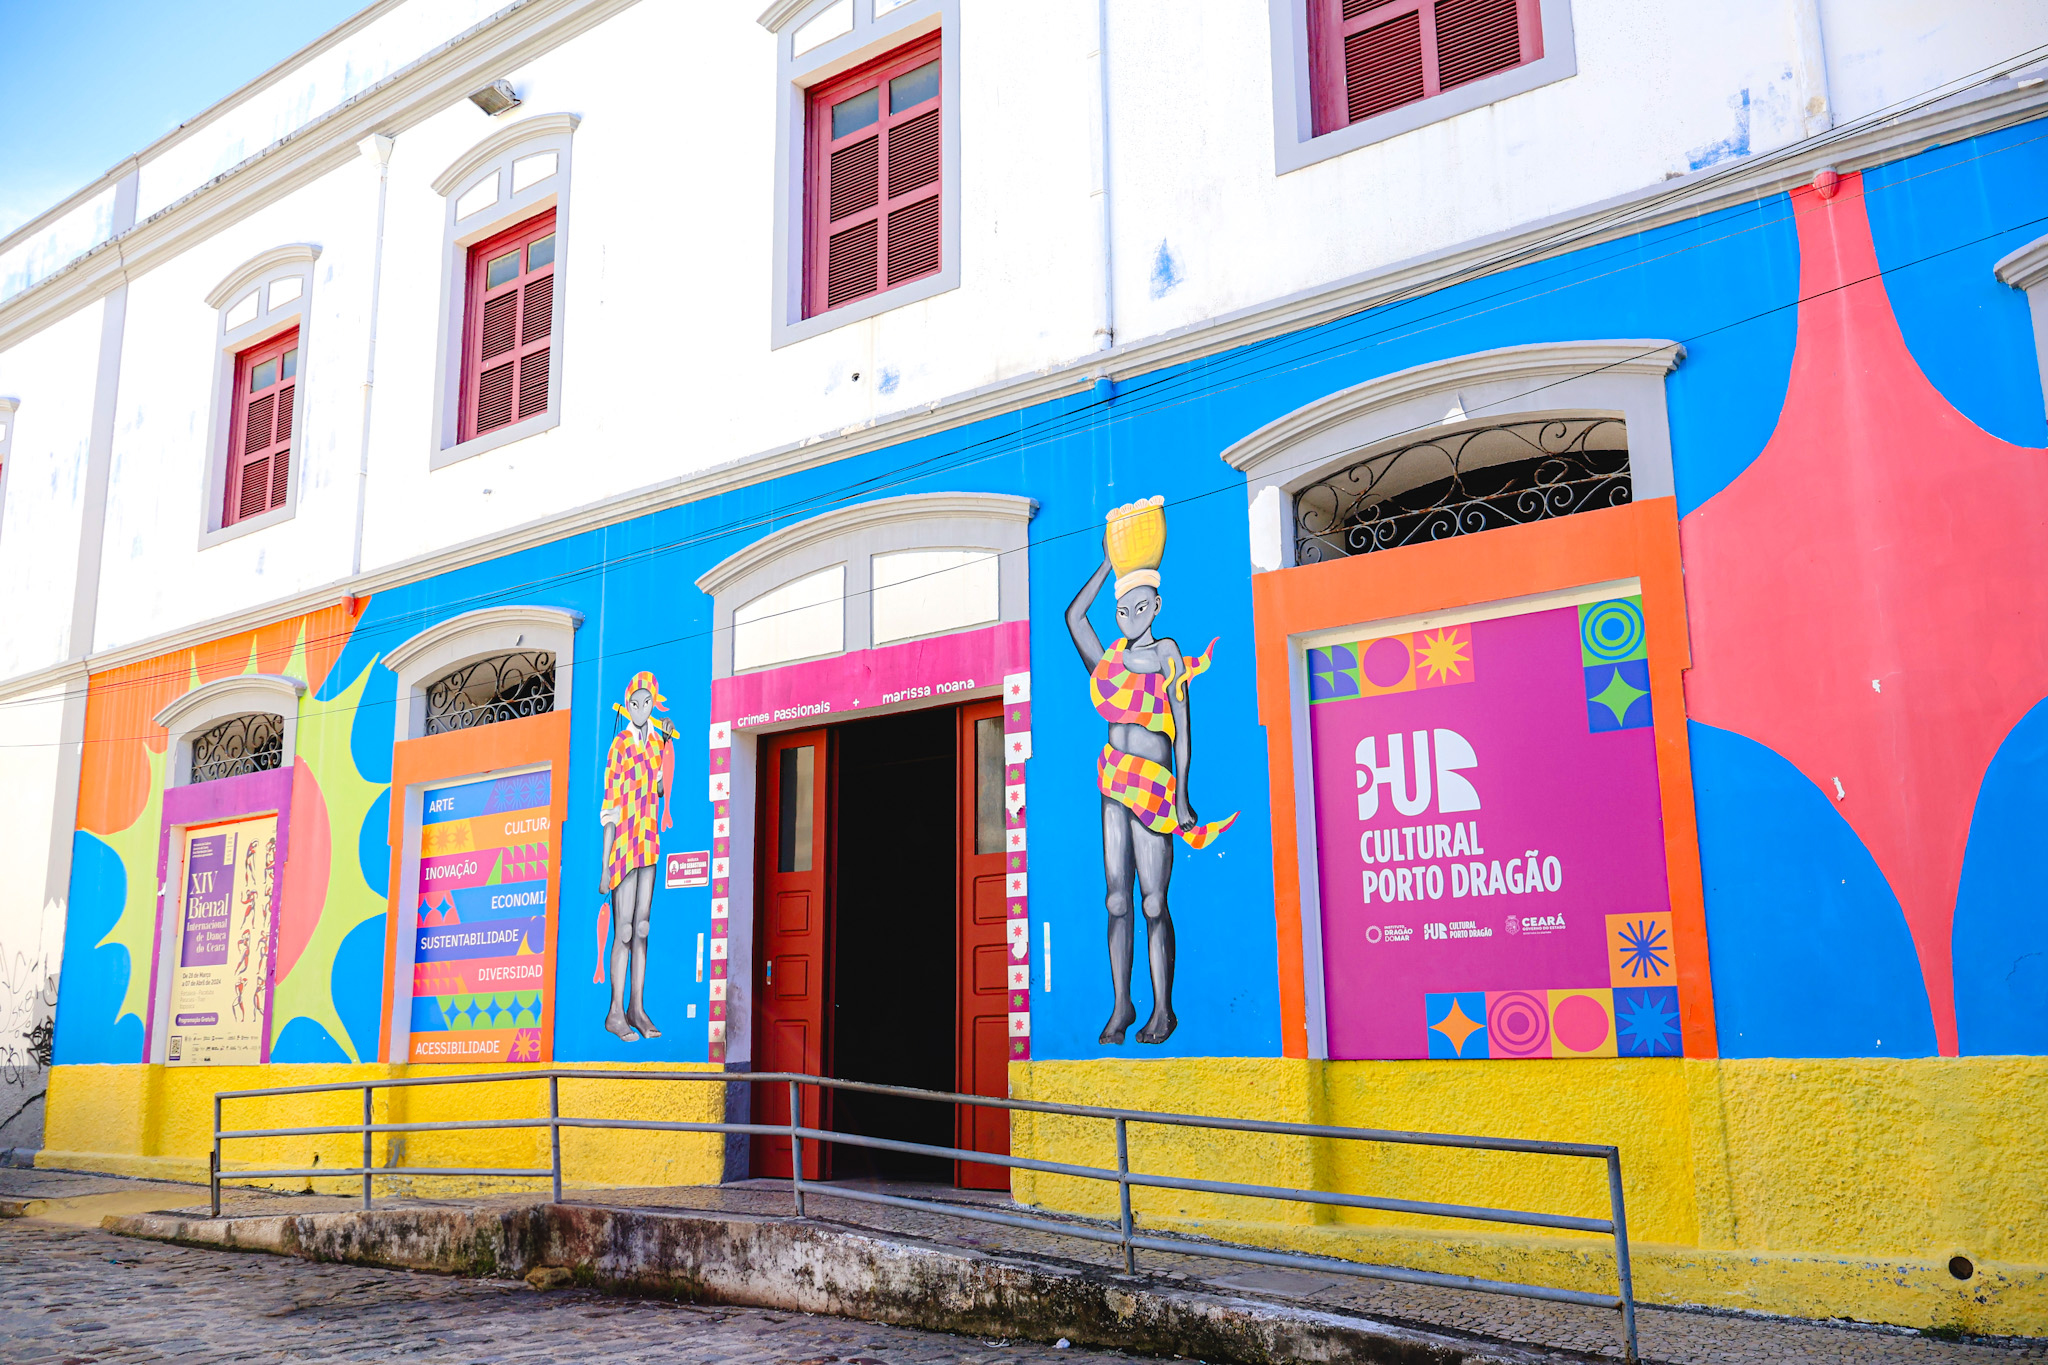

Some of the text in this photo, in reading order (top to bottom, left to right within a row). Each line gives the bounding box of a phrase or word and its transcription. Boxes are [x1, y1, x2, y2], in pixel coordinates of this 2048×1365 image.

[737, 710, 770, 728] crimes
[774, 701, 831, 721] passionais
[882, 684, 931, 704] marissa
[936, 678, 975, 694] noana
[1355, 728, 1481, 820] HUB
[429, 797, 455, 813] ARTE
[1360, 821, 1484, 864] CULTURAL
[425, 859, 478, 880] INOVAÇÃO
[1362, 850, 1562, 904] PORTO DRAGÃO
[190, 871, 218, 894] XIV
[188, 893, 229, 919] Bienal
[491, 890, 547, 909] ECONOMI
[186, 919, 227, 931] Internacional
[1449, 921, 1476, 930] CULTURAL
[1521, 912, 1566, 927] CEARÁ
[196, 931, 226, 942] de Dança
[420, 929, 519, 950] SUSTENTABILIDADE
[1384, 927, 1413, 935] DRAGÃO
[1450, 927, 1493, 939] PORTO DRAGÃO
[196, 943, 204, 953] do
[415, 1040, 500, 1055] ACESSIBILIDADE
